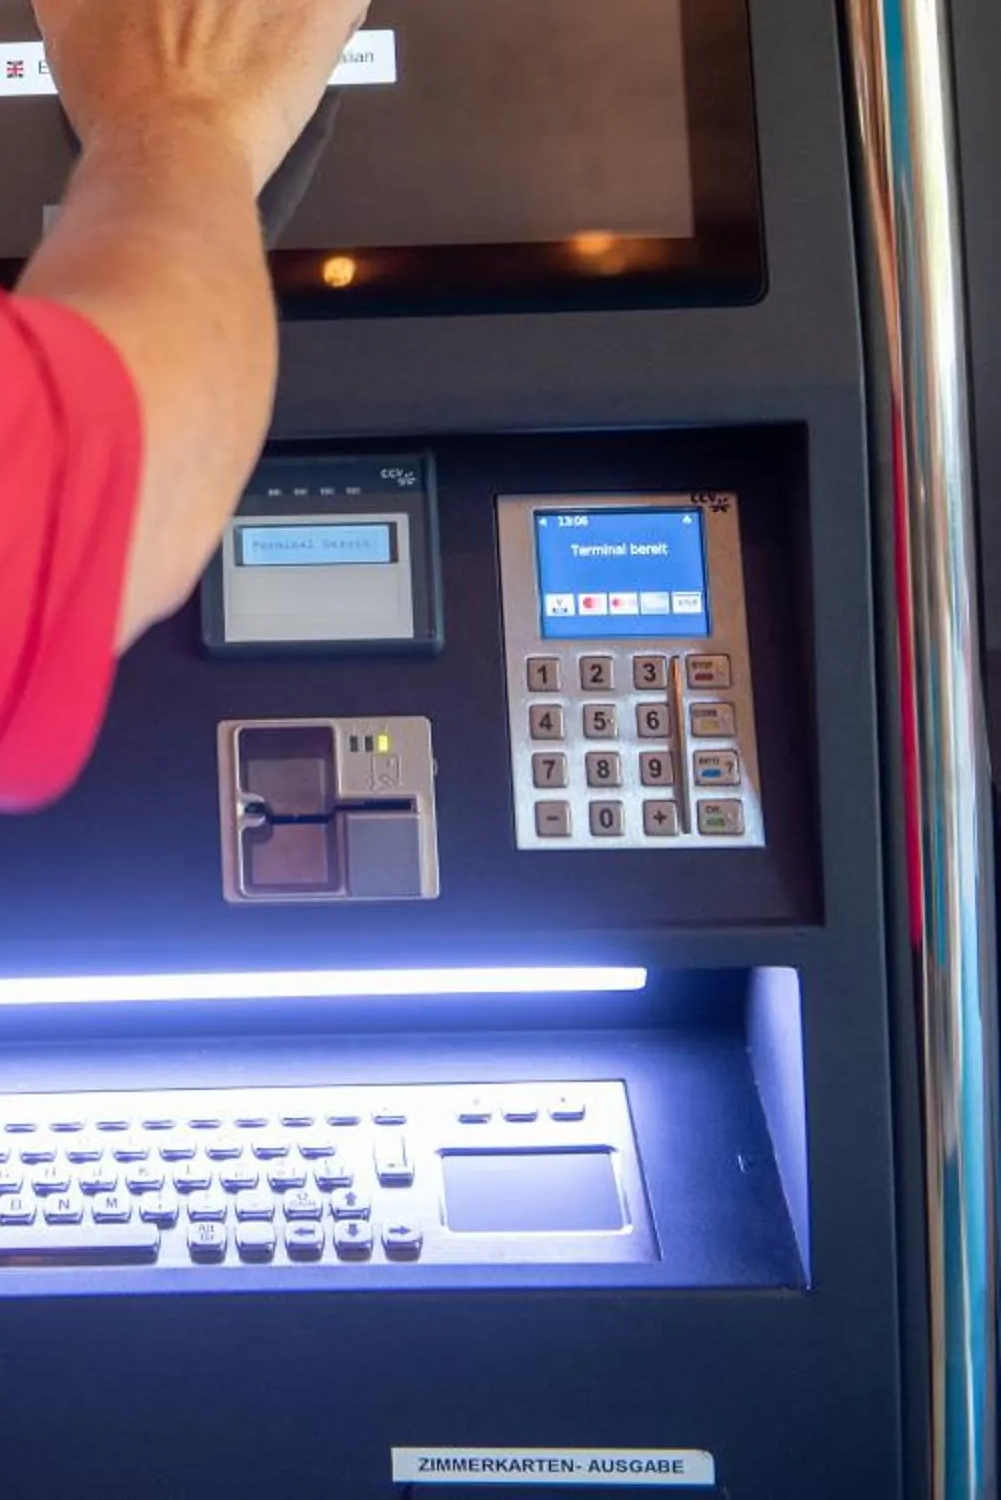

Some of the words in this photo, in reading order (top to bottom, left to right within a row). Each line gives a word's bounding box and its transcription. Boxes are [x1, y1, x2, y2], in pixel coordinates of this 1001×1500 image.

[570, 543, 627, 558] Terminal
[629, 541, 669, 557] bereit
[536, 664, 549, 686] 1
[589, 663, 604, 684] 2
[642, 662, 657, 683] 3
[538, 712, 554, 732] 4
[592, 711, 607, 732] 5
[645, 709, 660, 731] 6
[541, 758, 556, 781] 7
[596, 758, 611, 779] 8
[648, 757, 663, 779] 9
[599, 807, 614, 830] 0
[58, 1198, 71, 1210] N
[105, 1197, 119, 1209] M
[417, 1456, 582, 1475] ZIMMERKARTEN-
[587, 1458, 686, 1476] AUSGABE
